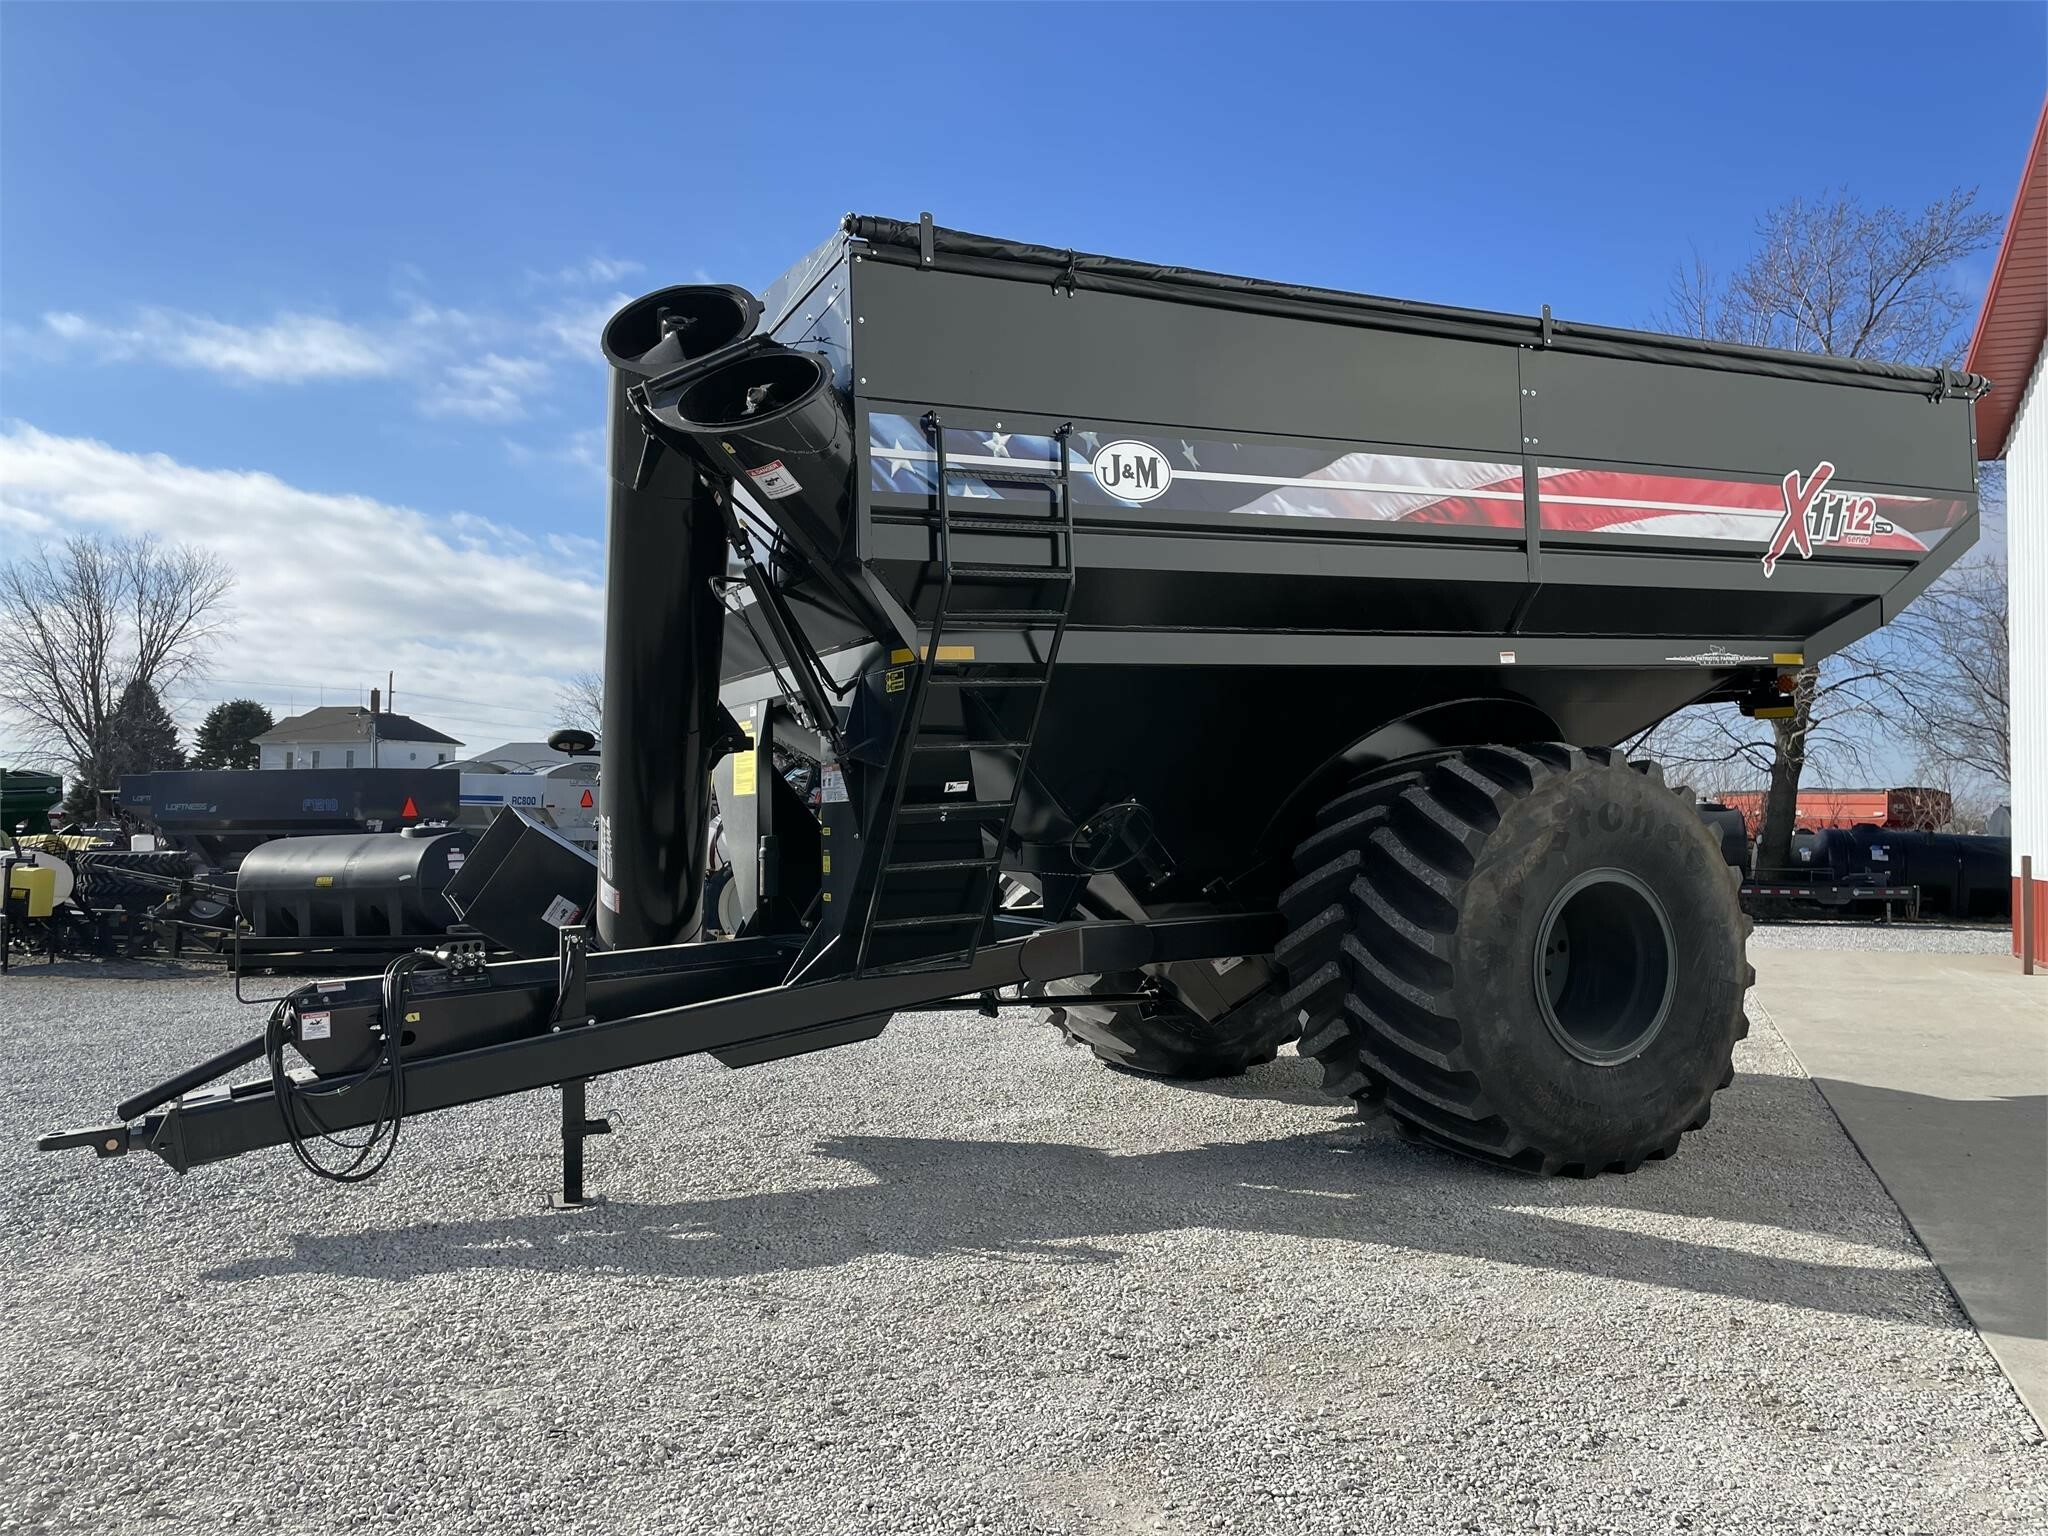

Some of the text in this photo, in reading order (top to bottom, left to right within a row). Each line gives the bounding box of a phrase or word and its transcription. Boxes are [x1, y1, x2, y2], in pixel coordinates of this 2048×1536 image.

[1101, 454, 1160, 489] J&M
[1847, 535, 1870, 545] series
[511, 795, 536, 806] RC800
[165, 803, 208, 811] LOFTNESS
